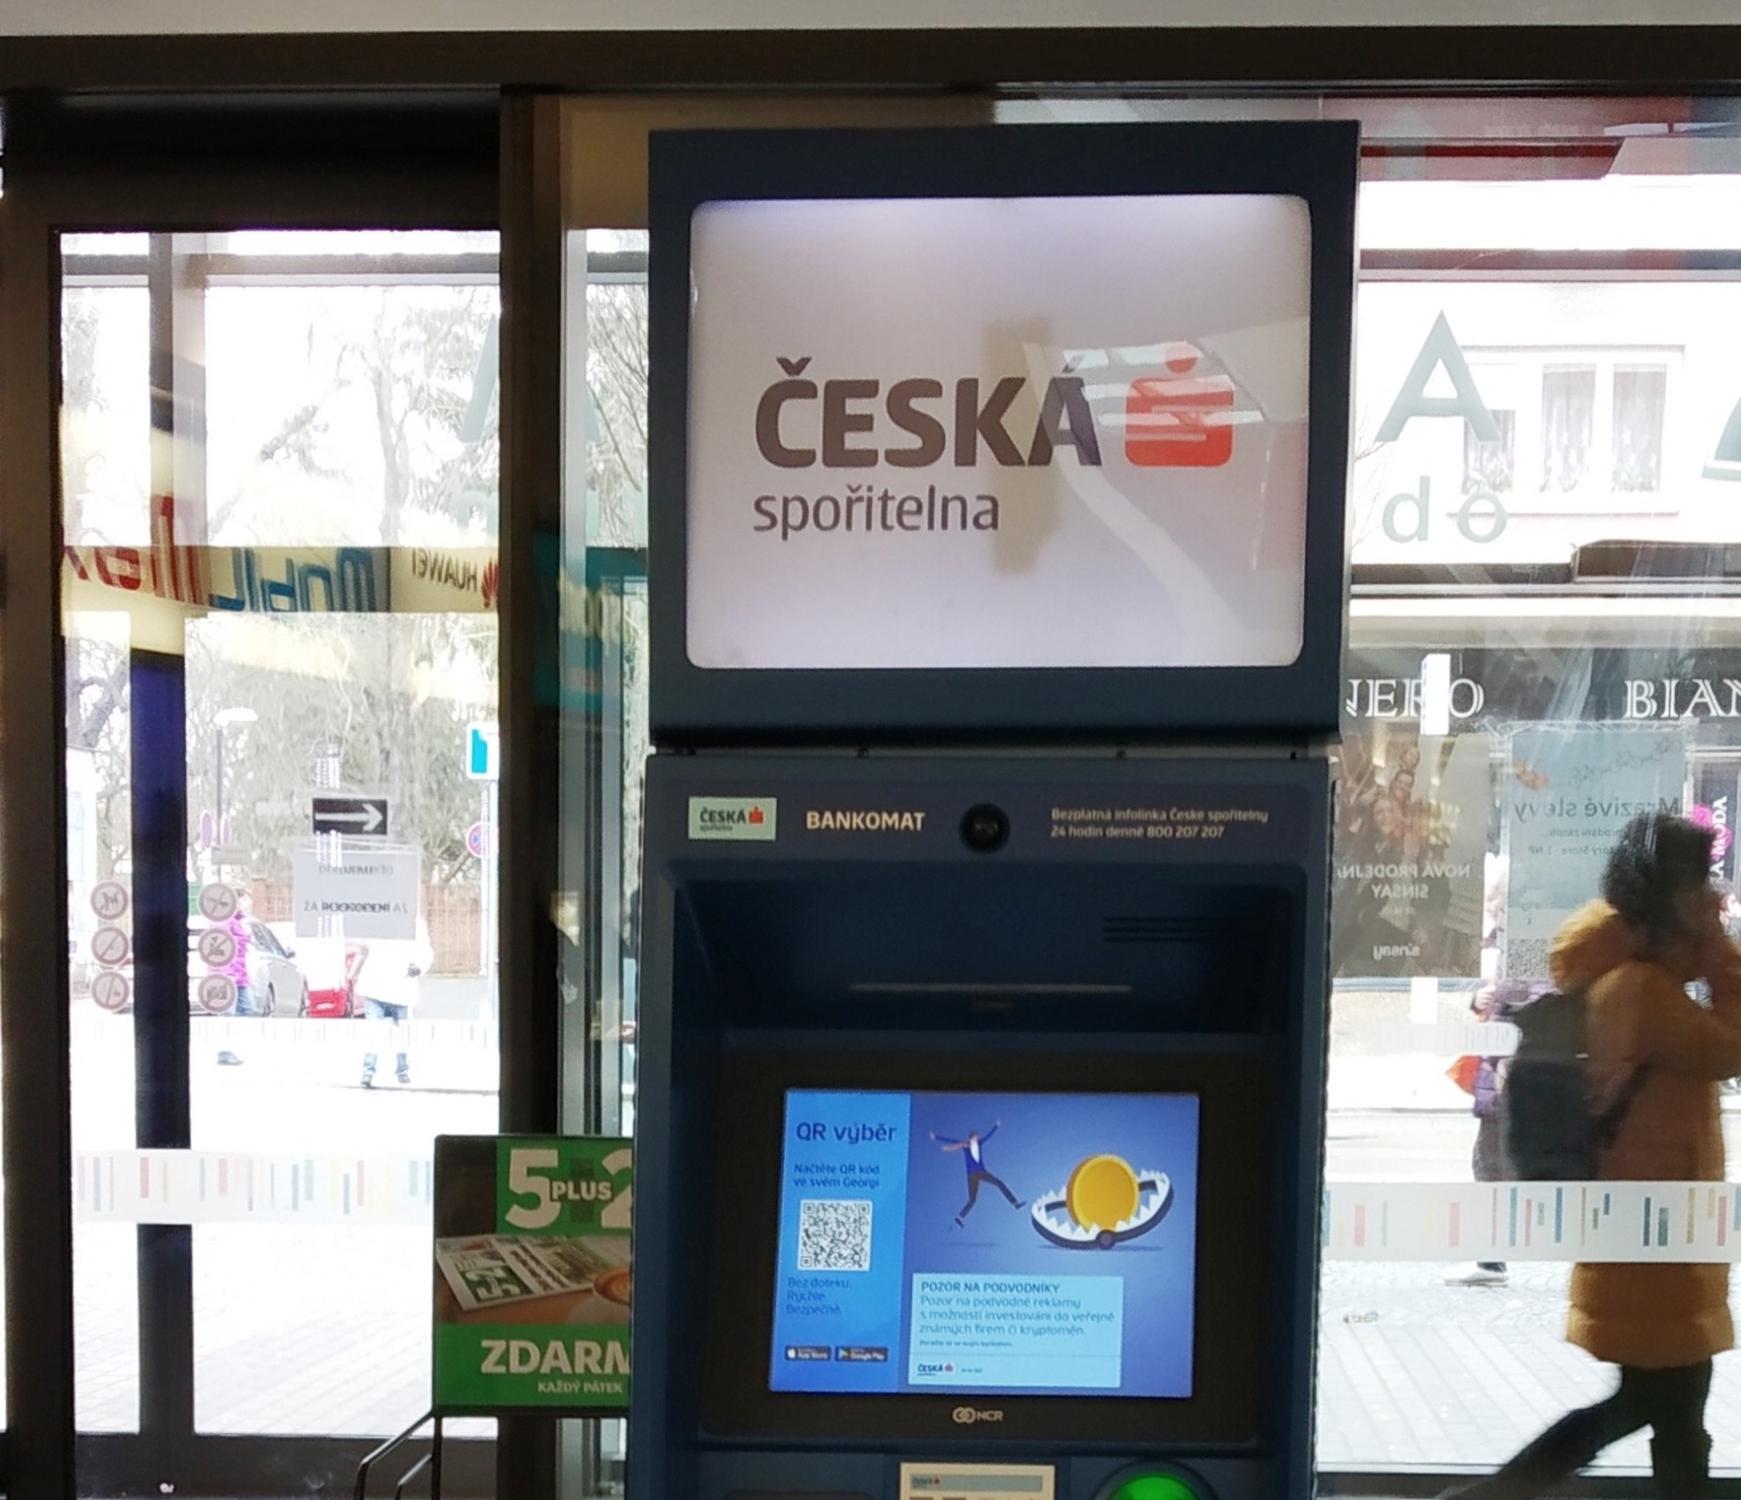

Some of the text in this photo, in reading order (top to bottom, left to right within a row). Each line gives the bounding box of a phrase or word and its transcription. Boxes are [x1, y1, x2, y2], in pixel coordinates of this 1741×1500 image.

[754, 356, 1102, 467] ČESKÁ
[753, 484, 999, 541] spořitelna
[700, 806, 746, 824] ČESKÁ
[806, 810, 926, 832] BANKOMAT
[1051, 807, 1112, 823] Bezplatná
[1114, 807, 1167, 821] infolinka
[1208, 807, 1269, 823] spořitelny
[1051, 825, 1225, 838] 24 hodin denně 800 207 207
[796, 1122, 897, 1145] QR výběr
[794, 1163, 879, 1174] Načtěte QR kód
[793, 1179, 807, 1188] ve
[810, 1177, 841, 1188] svém
[552, 1181, 612, 1200] PLUS
[921, 1281, 1060, 1294] POZOR NA PODVODNÍKY
[921, 1296, 1081, 1309] Pozor na podvodné reklamy
[1055, 1311, 1069, 1321] do
[919, 1323, 972, 1336] známých
[975, 1324, 1005, 1334] firem
[480, 1340, 631, 1375] ZDARM
[538, 1380, 623, 1394] KAŽDÝ PÁTEK
[977, 1410, 1004, 1421] NCR
